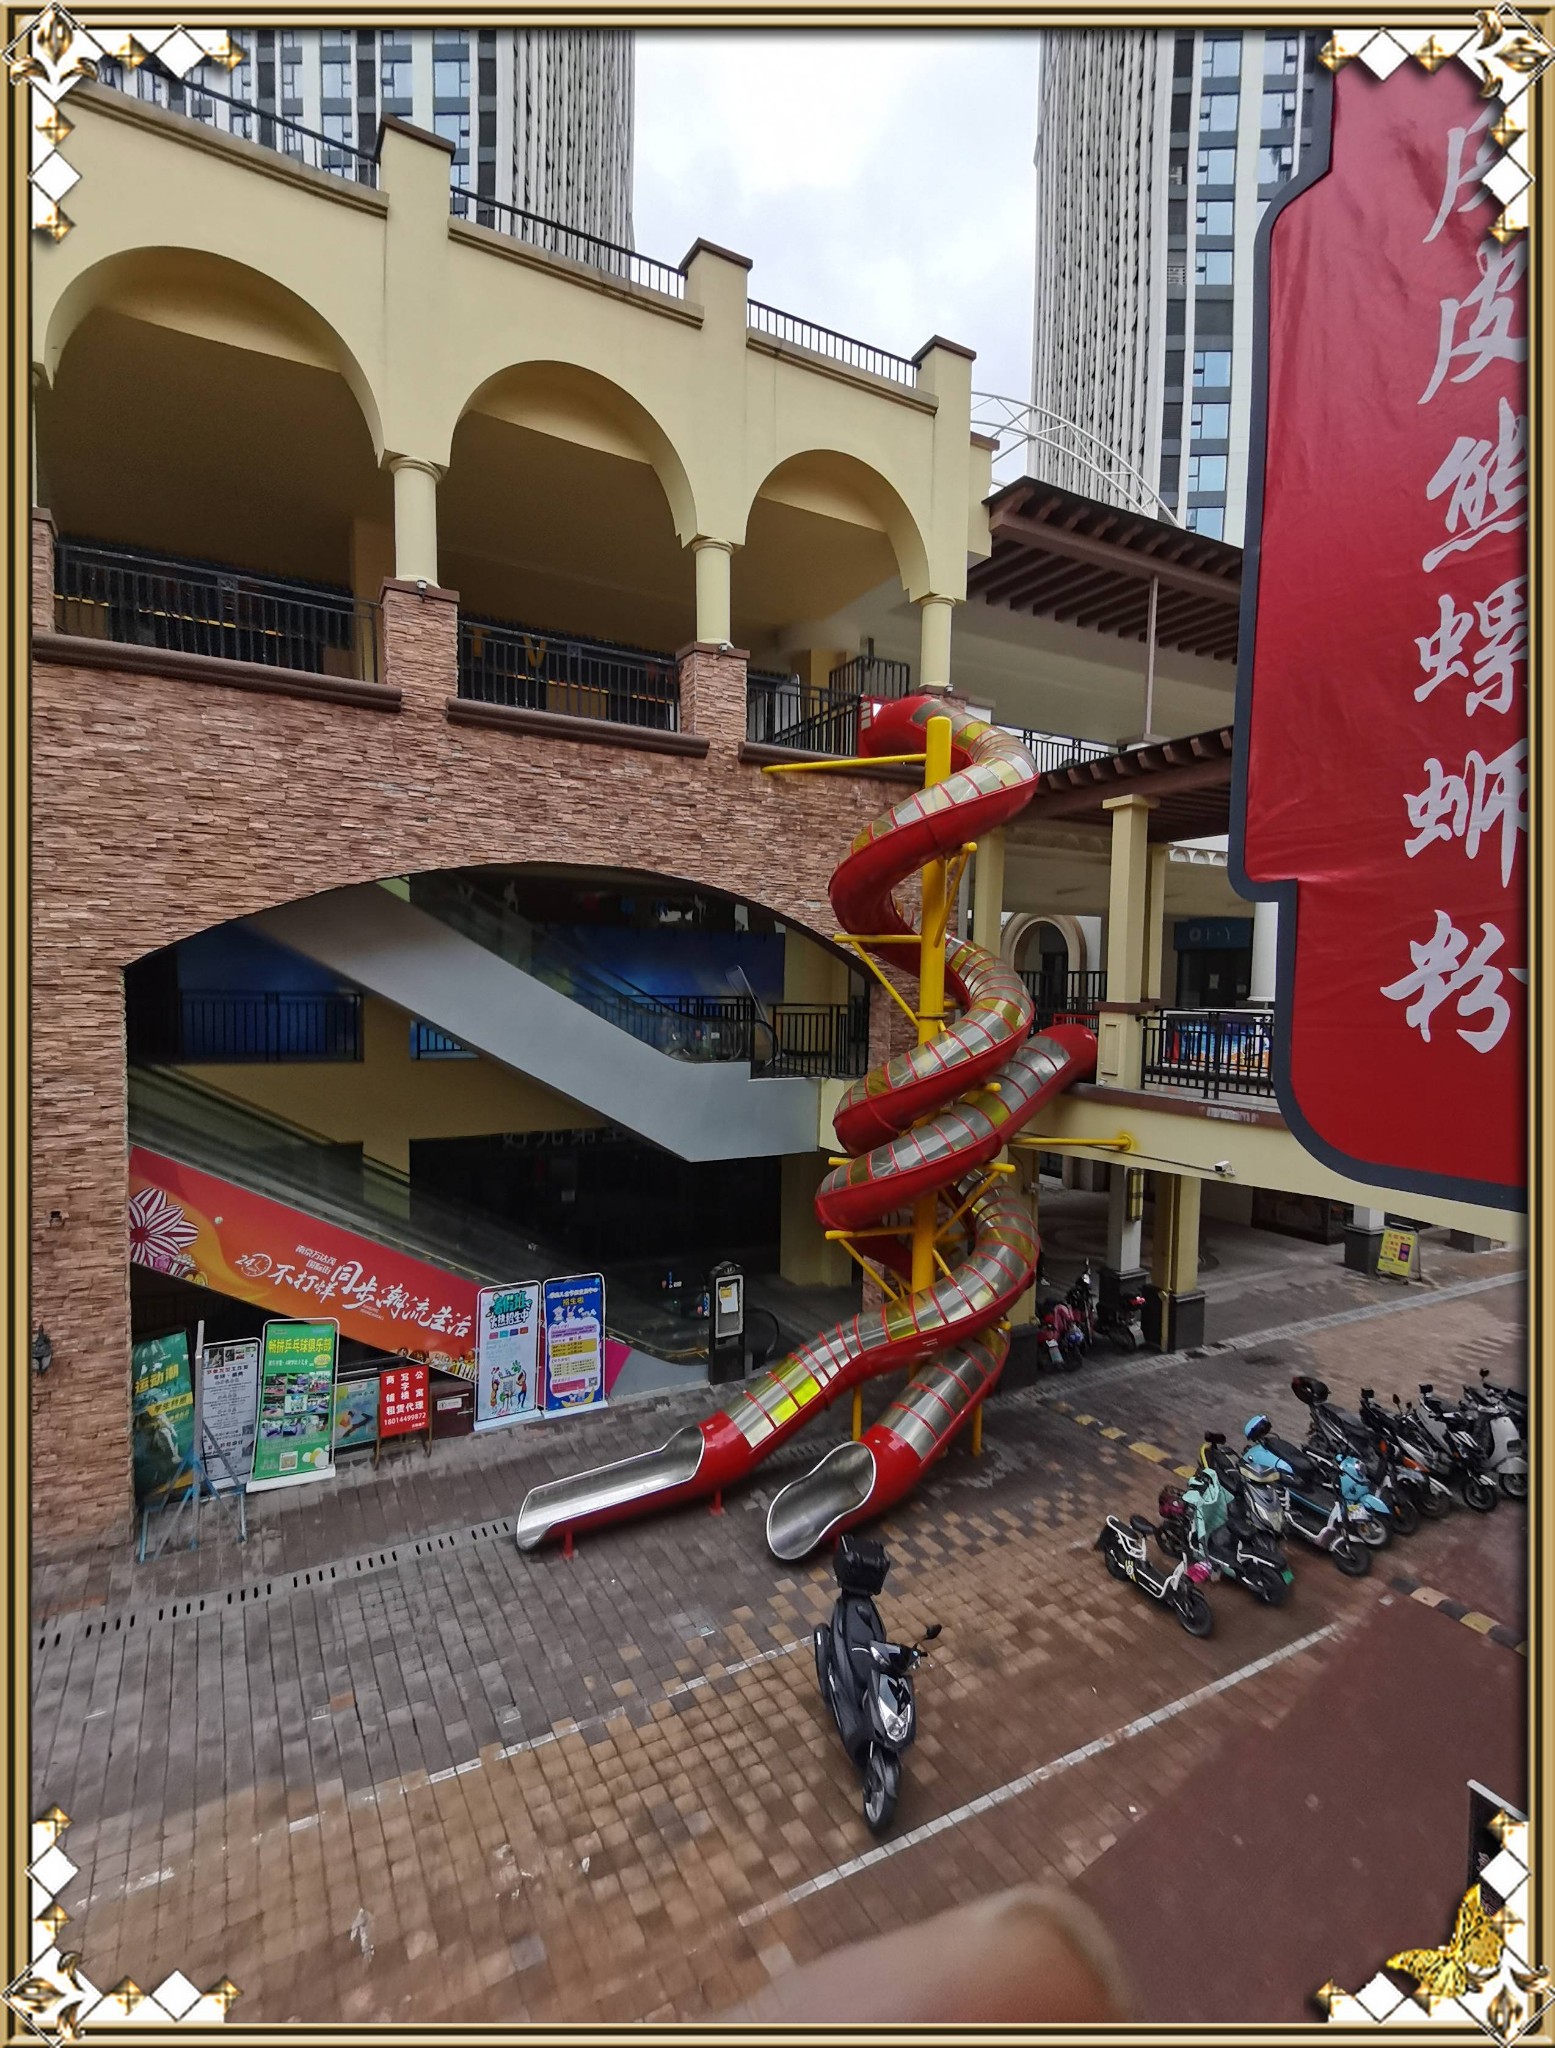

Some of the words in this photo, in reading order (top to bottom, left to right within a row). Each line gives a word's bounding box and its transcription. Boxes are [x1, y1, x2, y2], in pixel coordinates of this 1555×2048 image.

[385, 1400, 425, 1416] 租赁代理
[383, 1412, 427, 1426] 18014499872
